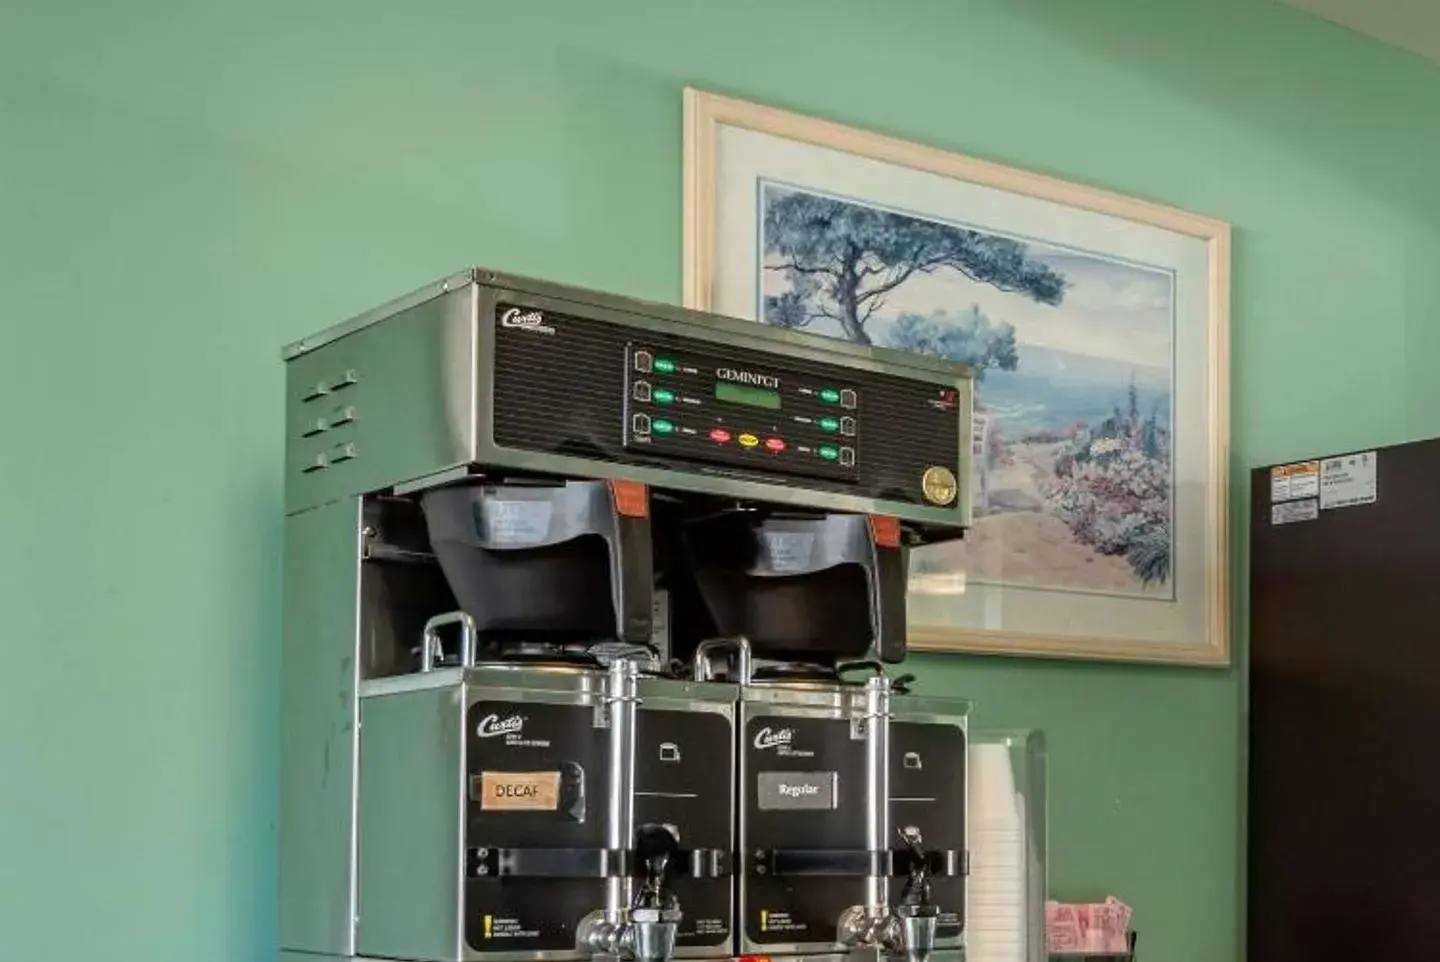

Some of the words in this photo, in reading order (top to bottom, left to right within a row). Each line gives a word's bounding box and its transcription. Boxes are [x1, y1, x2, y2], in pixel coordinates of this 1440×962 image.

[477, 714, 523, 737] Curtis
[495, 784, 539, 798] DECAF
[778, 784, 819, 798] Regular
